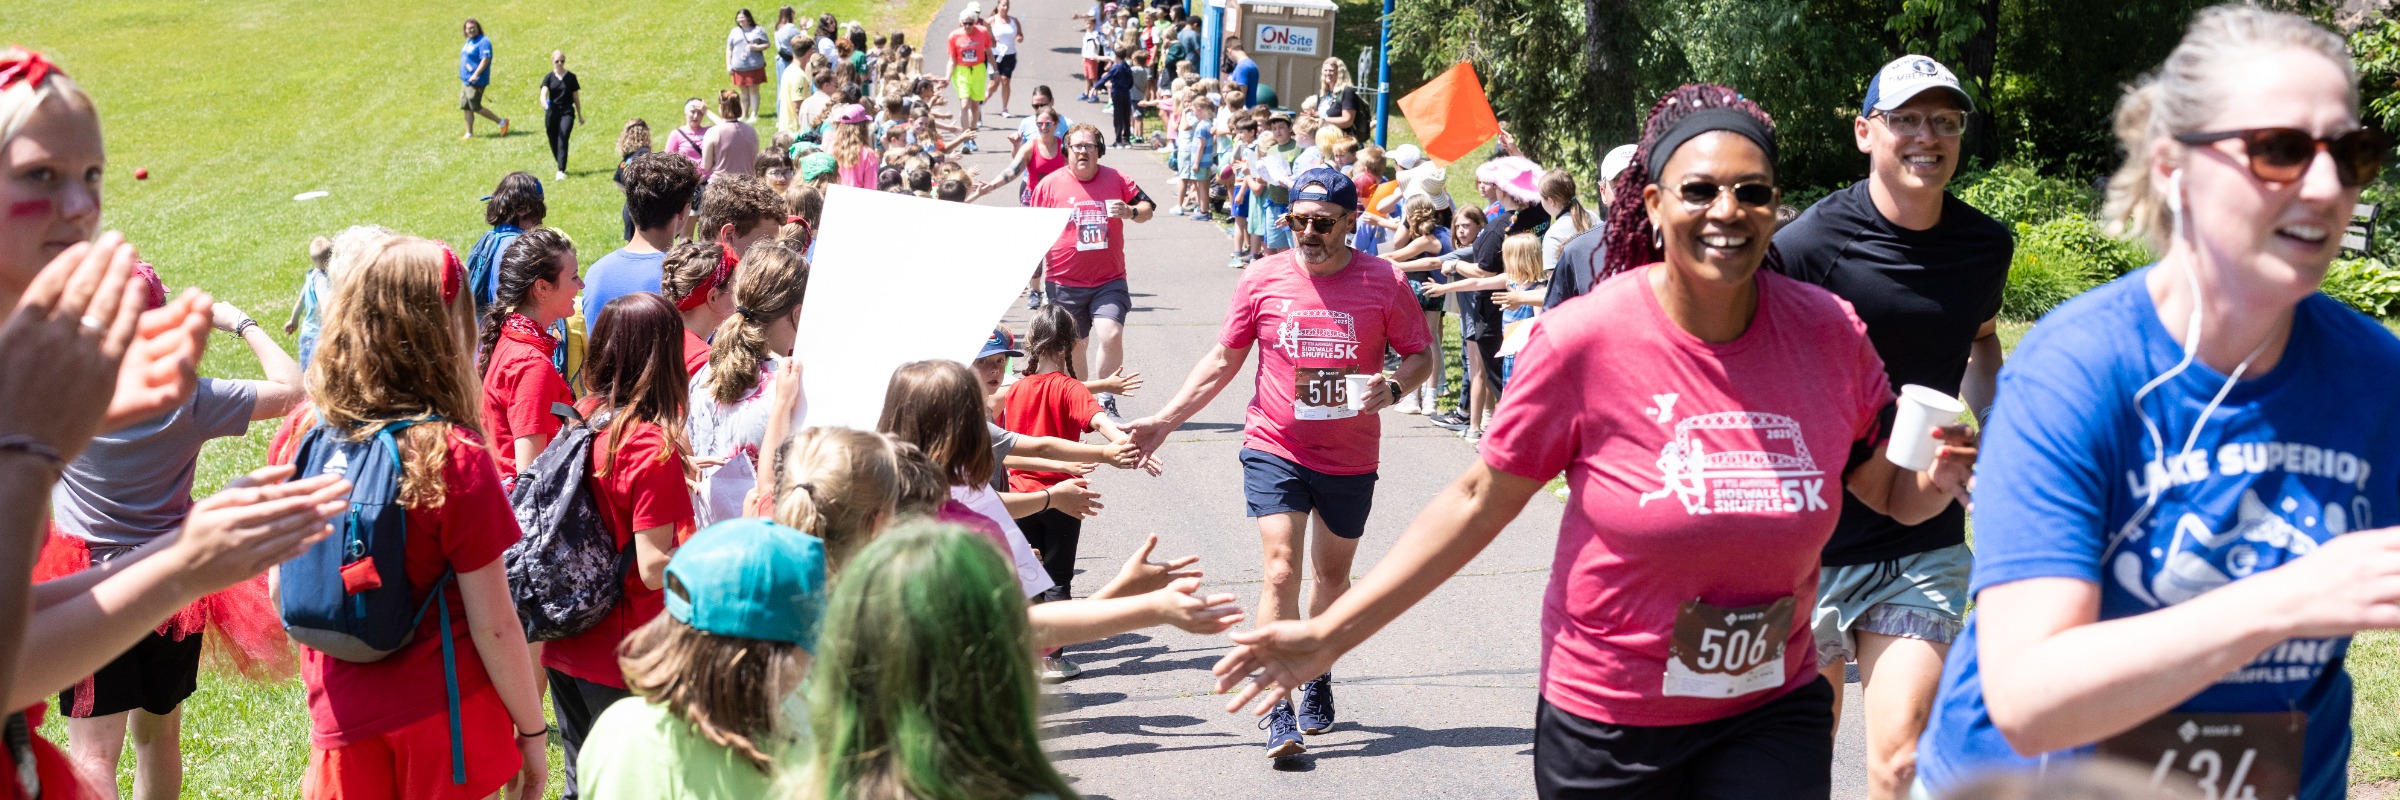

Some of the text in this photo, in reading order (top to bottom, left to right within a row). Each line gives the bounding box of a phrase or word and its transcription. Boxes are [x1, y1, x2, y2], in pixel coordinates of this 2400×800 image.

[1082, 229, 1102, 243] 811
[1334, 344, 1359, 359] 5K
[1309, 380, 1346, 404] 515
[2126, 448, 2210, 499] LAKE
[1713, 489, 1779, 499] SIDEWALK
[1781, 478, 1828, 512] 5K
[1714, 499, 1782, 512] SHUFFLE
[1697, 623, 1769, 670] 506
